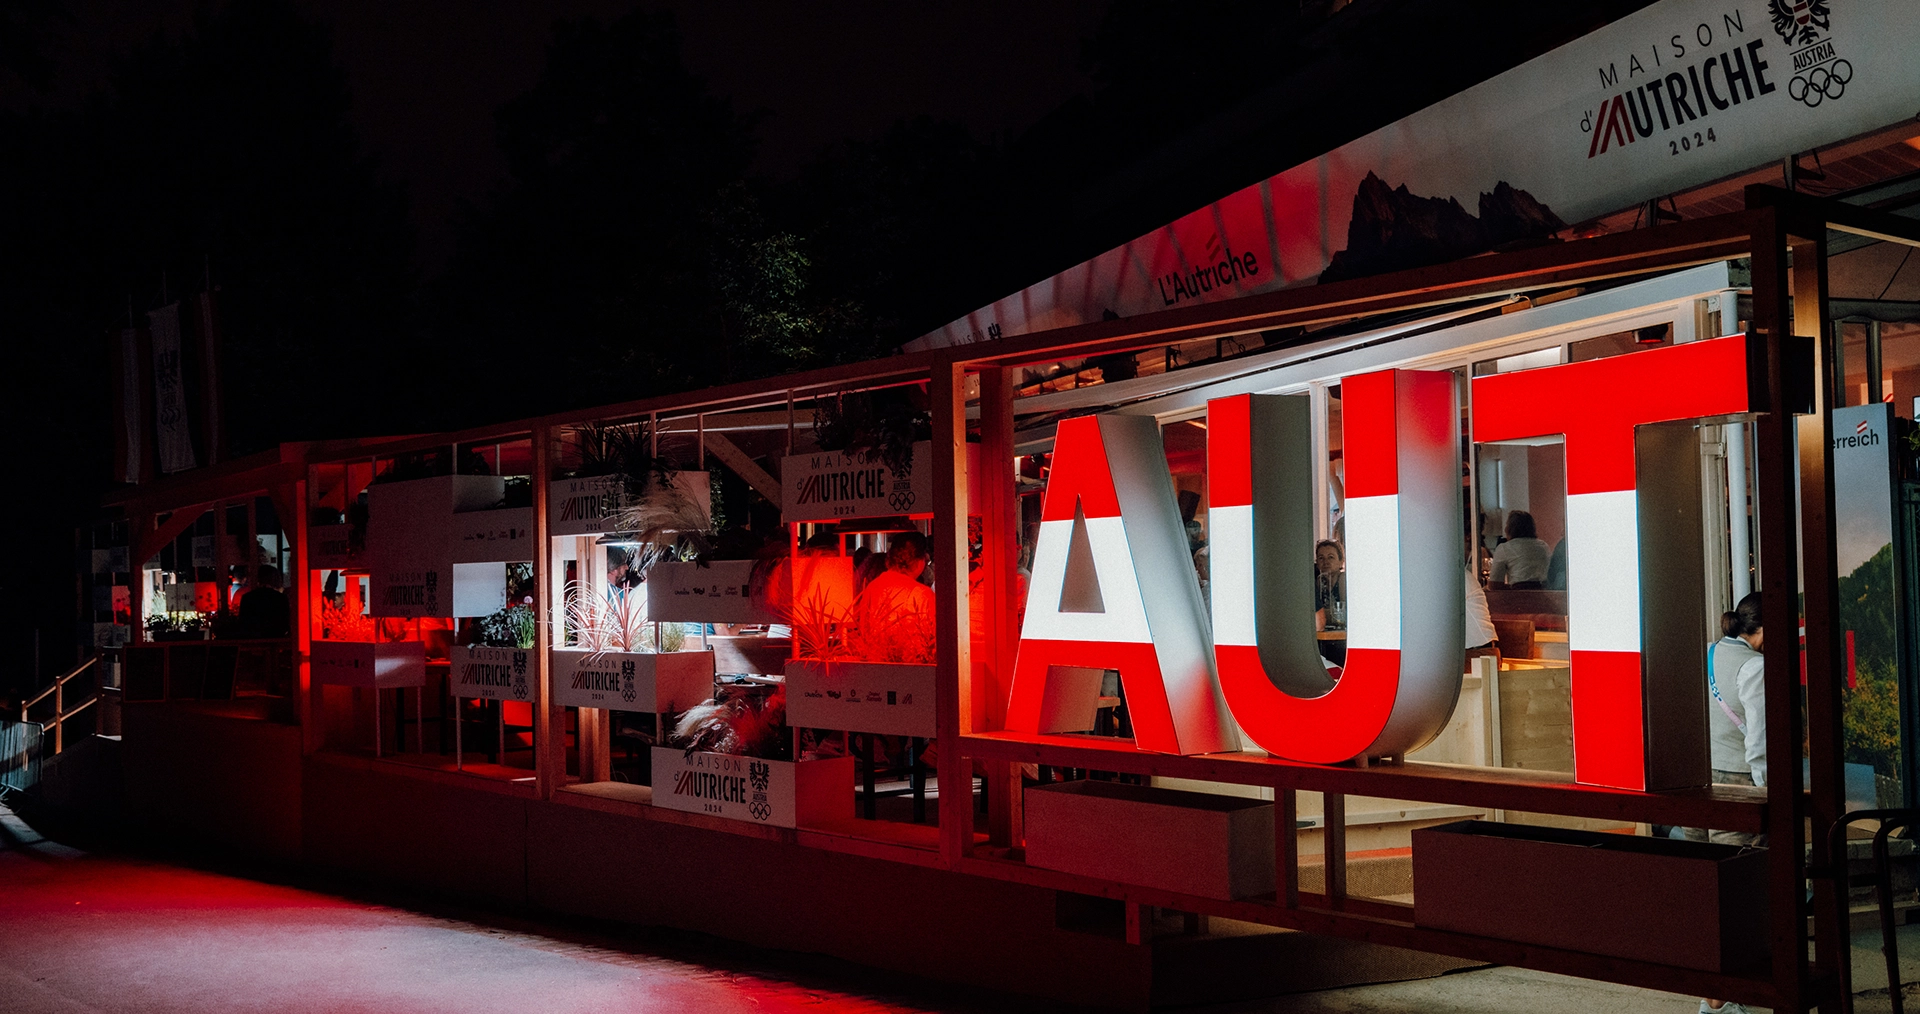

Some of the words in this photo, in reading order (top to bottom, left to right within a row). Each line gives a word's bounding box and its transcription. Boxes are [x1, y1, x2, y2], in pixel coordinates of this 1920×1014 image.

[1598, 9, 1744, 89] MAISON
[1793, 42, 1836, 71] AUSTRIA
[1669, 127, 1716, 156] 2024
[1158, 248, 1259, 306] L'Autriche
[834, 506, 855, 515] 2024
[1004, 332, 1770, 792] AUT
[685, 755, 741, 772] MAISON
[704, 803, 722, 813] 2024
